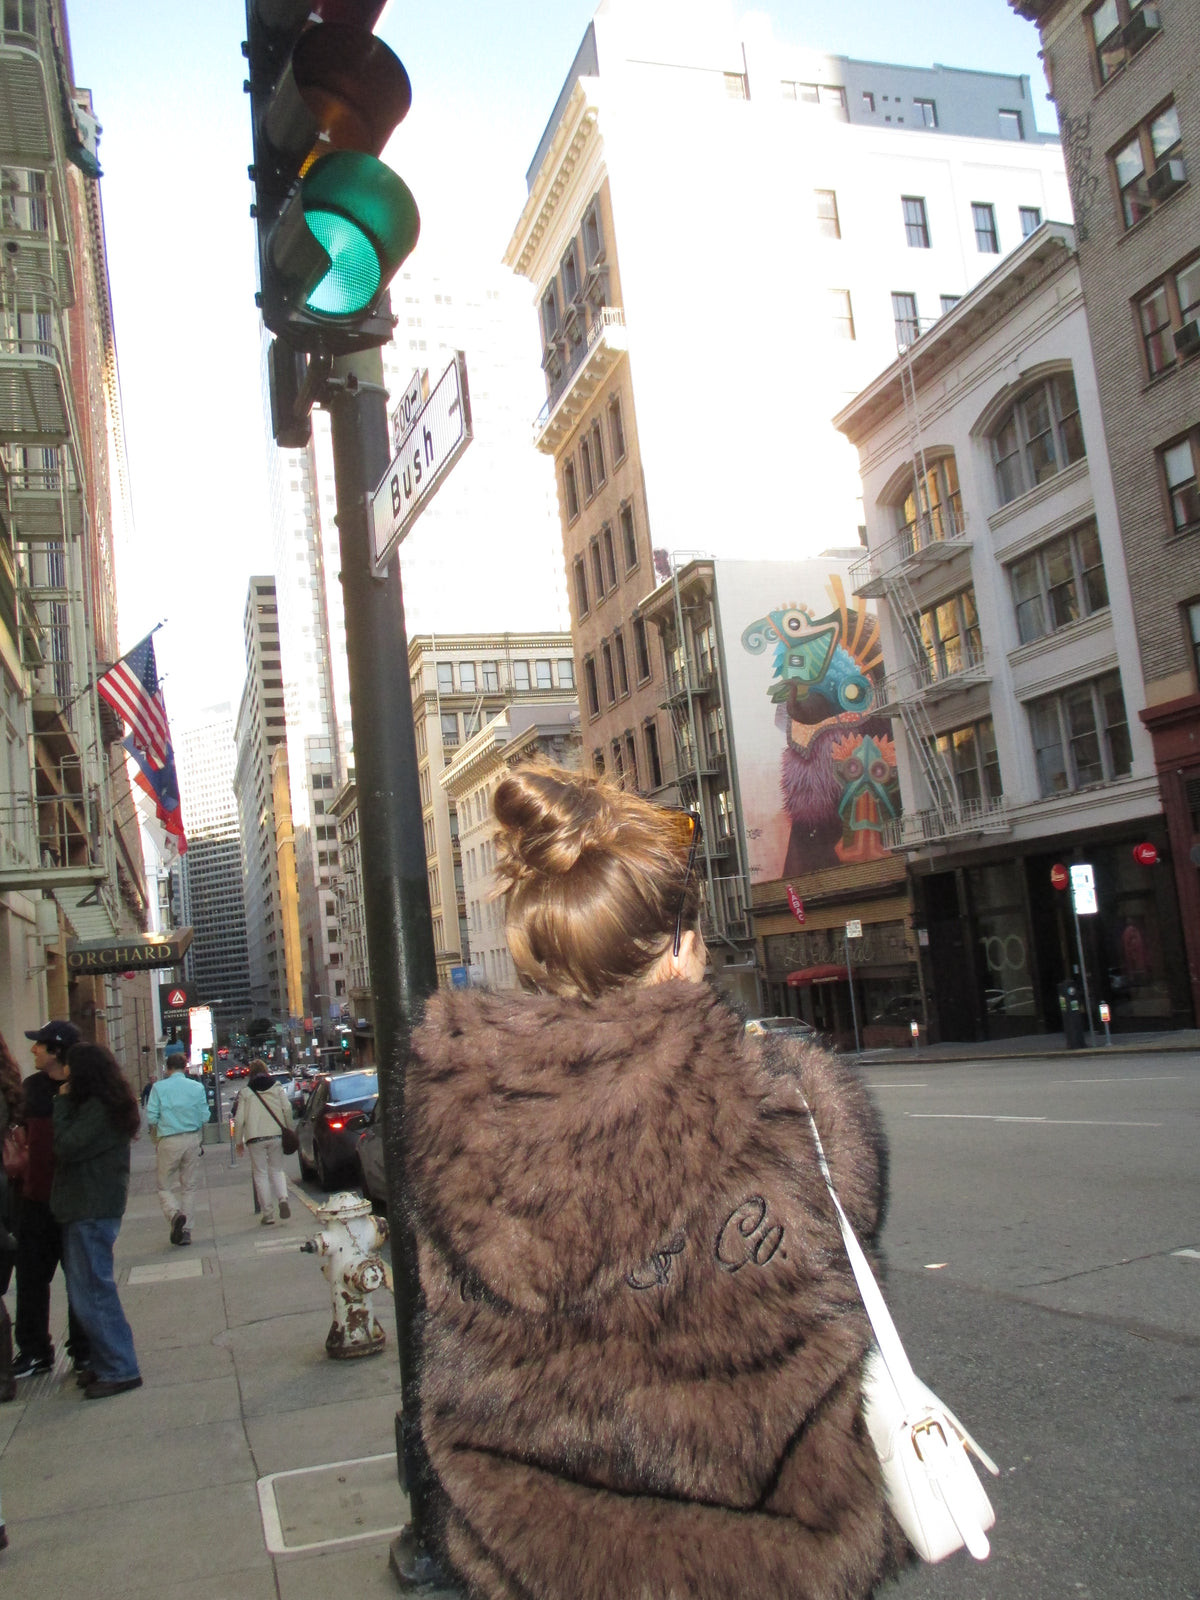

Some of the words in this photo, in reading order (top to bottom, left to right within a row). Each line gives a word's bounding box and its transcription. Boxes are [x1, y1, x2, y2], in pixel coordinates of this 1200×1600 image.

[393, 396, 412, 438] 500
[390, 425, 434, 519] Bush
[788, 886, 805, 921] TABAC
[68, 944, 172, 967] ORCHARD
